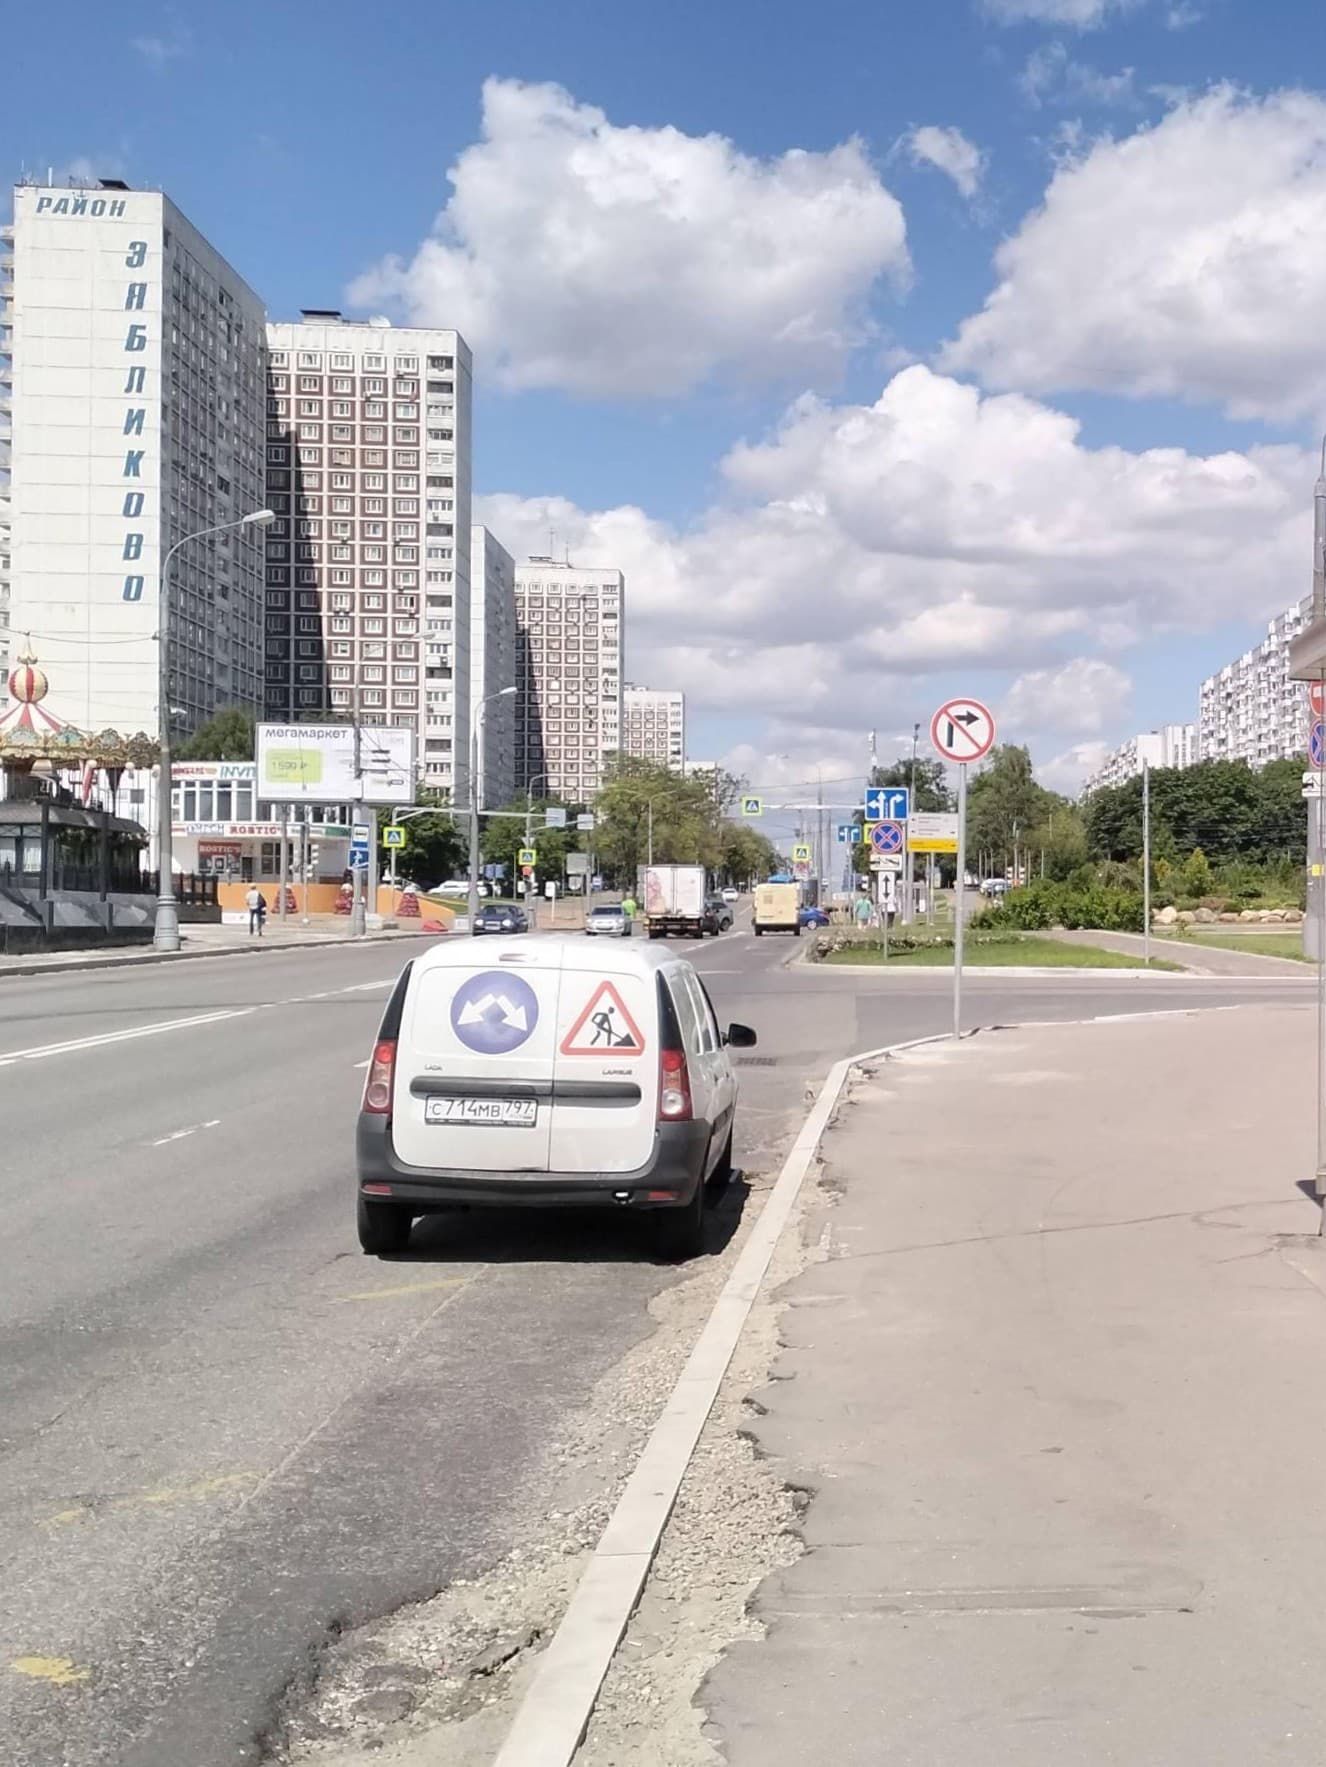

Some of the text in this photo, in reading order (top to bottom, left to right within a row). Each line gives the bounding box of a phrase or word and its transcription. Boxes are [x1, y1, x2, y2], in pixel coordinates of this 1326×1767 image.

[36, 196, 126, 217] РАЙОН
[122, 241, 147, 602] ЗЯБЛИКОВО
[265, 728, 349, 740] мегамаркет
[230, 826, 283, 835] ROSTIC'
